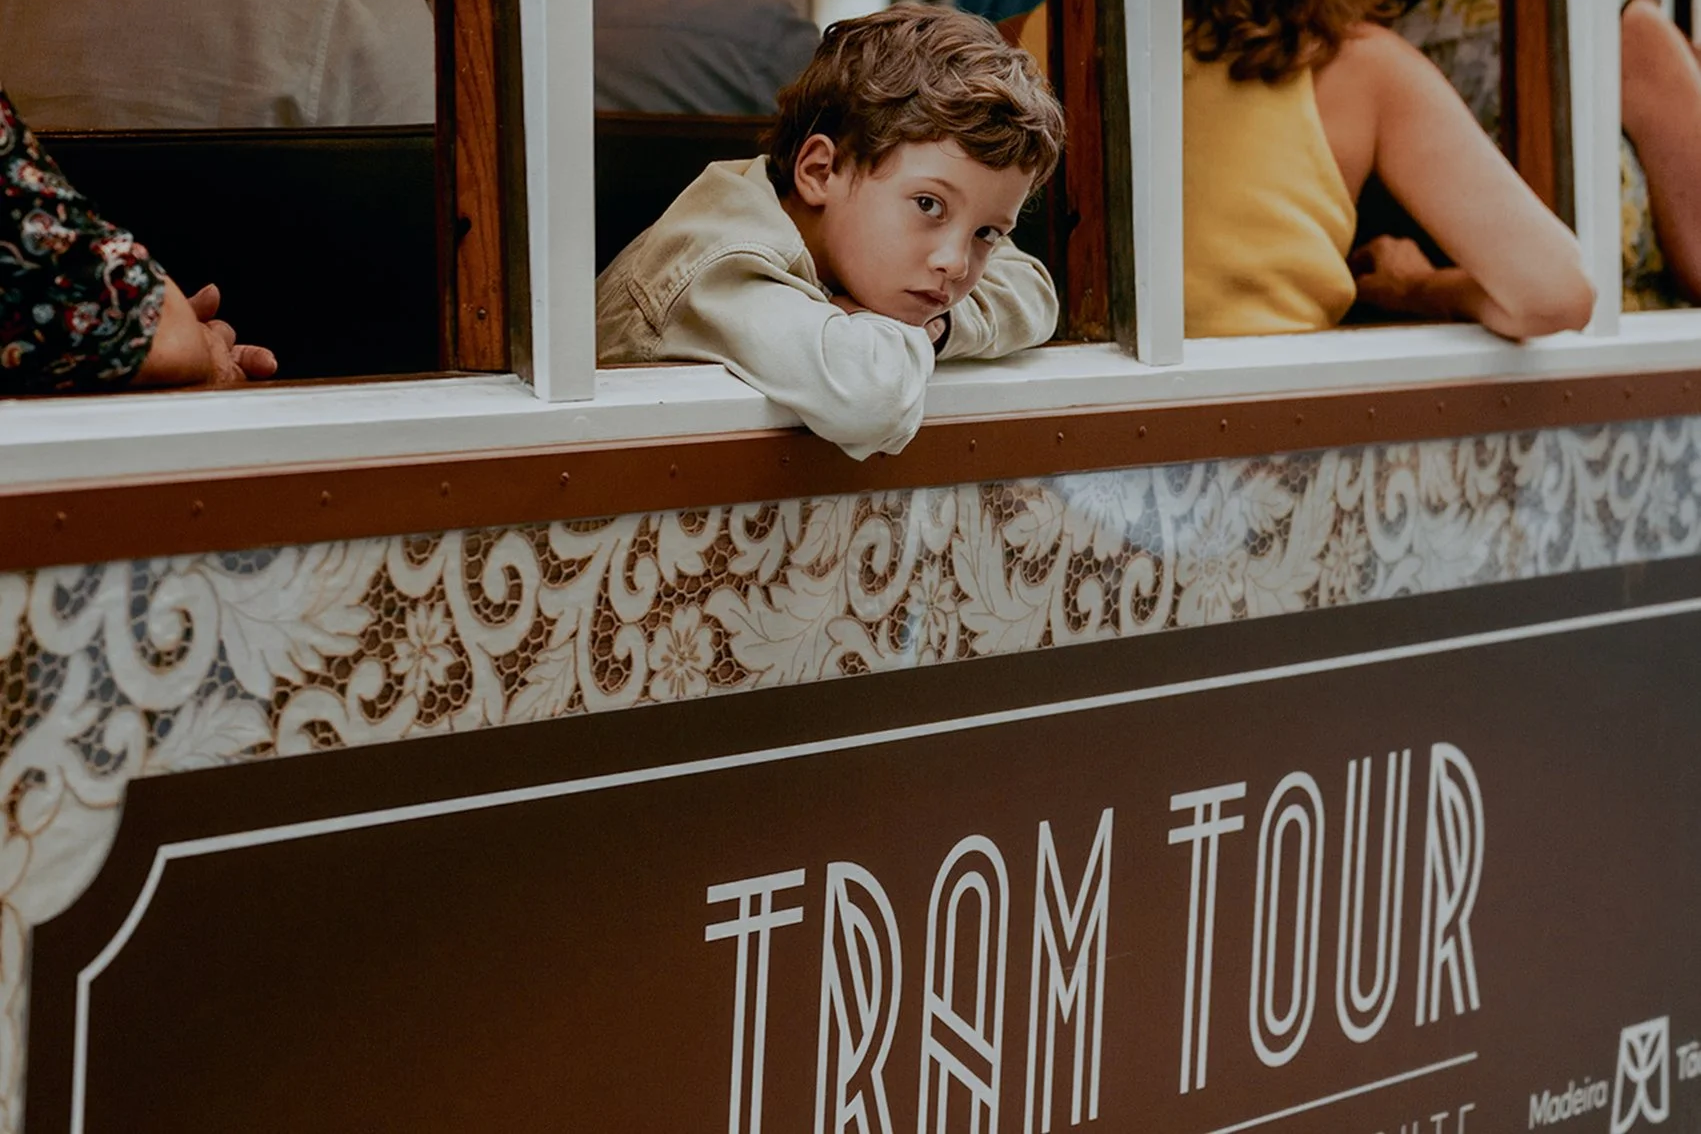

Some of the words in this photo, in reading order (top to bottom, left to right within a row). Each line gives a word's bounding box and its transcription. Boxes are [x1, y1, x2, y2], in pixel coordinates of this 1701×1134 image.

[705, 807, 1114, 1134] TRAM
[1168, 742, 1485, 1094] TOUR
[1528, 1076, 1610, 1130] Madeira
